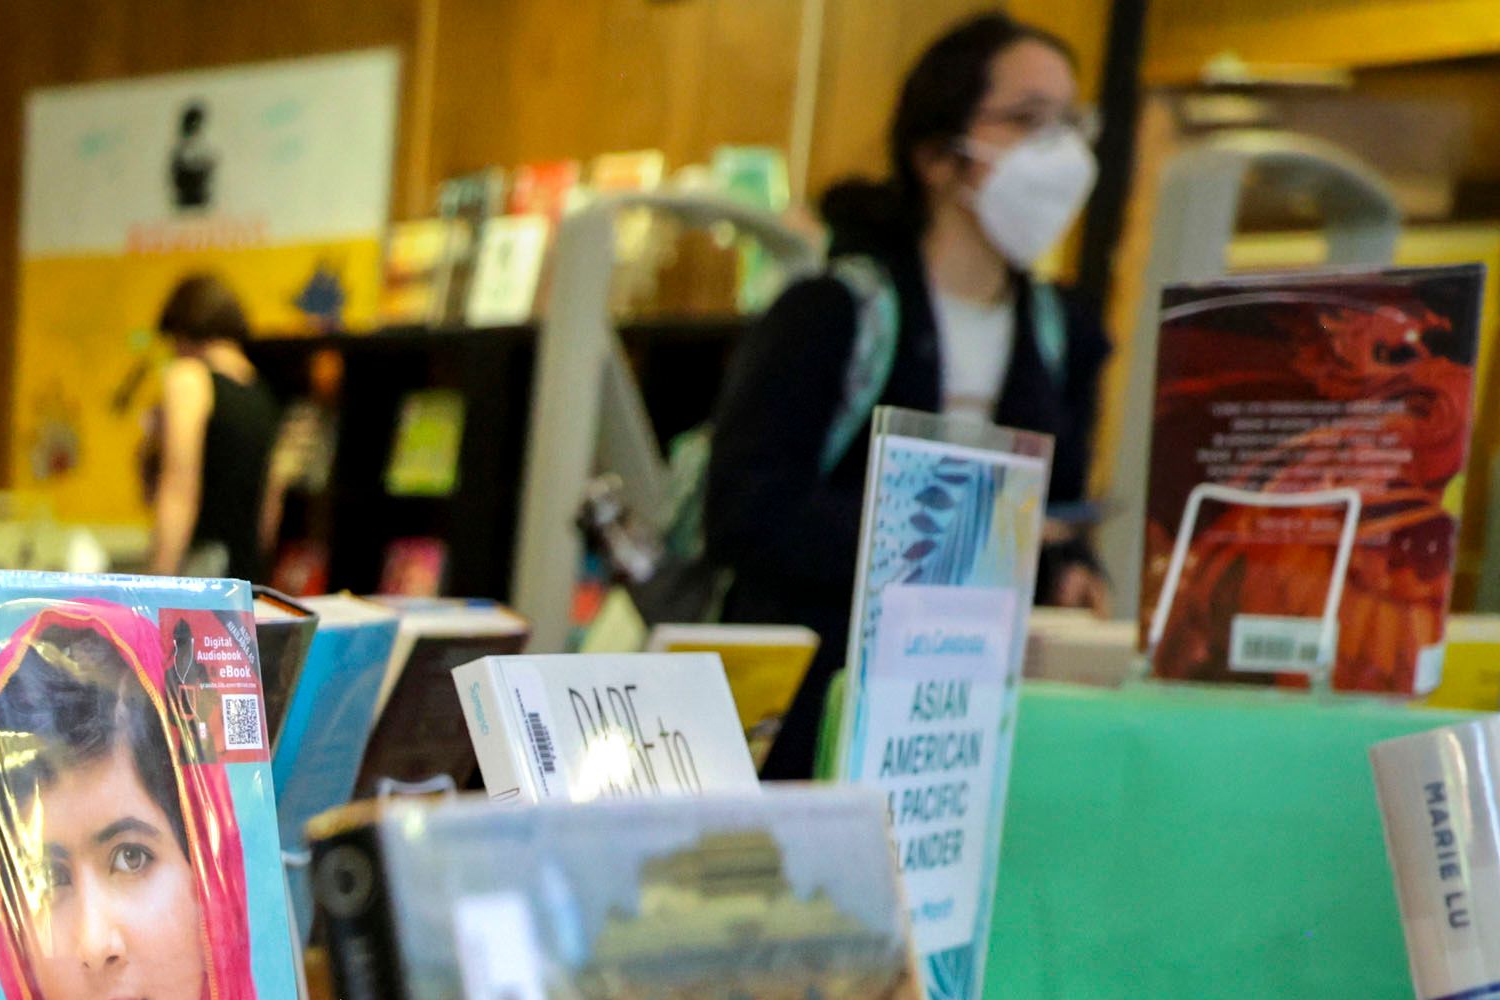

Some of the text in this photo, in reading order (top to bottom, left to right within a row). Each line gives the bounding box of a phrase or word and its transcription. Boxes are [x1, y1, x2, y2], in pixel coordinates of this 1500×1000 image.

[197, 651, 242, 660] Audiobook
[204, 637, 232, 649] Digital
[220, 666, 251, 678] eBook
[909, 680, 970, 721] ASIAN
[879, 729, 983, 778] AMERICAN
[900, 780, 969, 824] PACIFIC
[1424, 782, 1470, 929] MARIE LU
